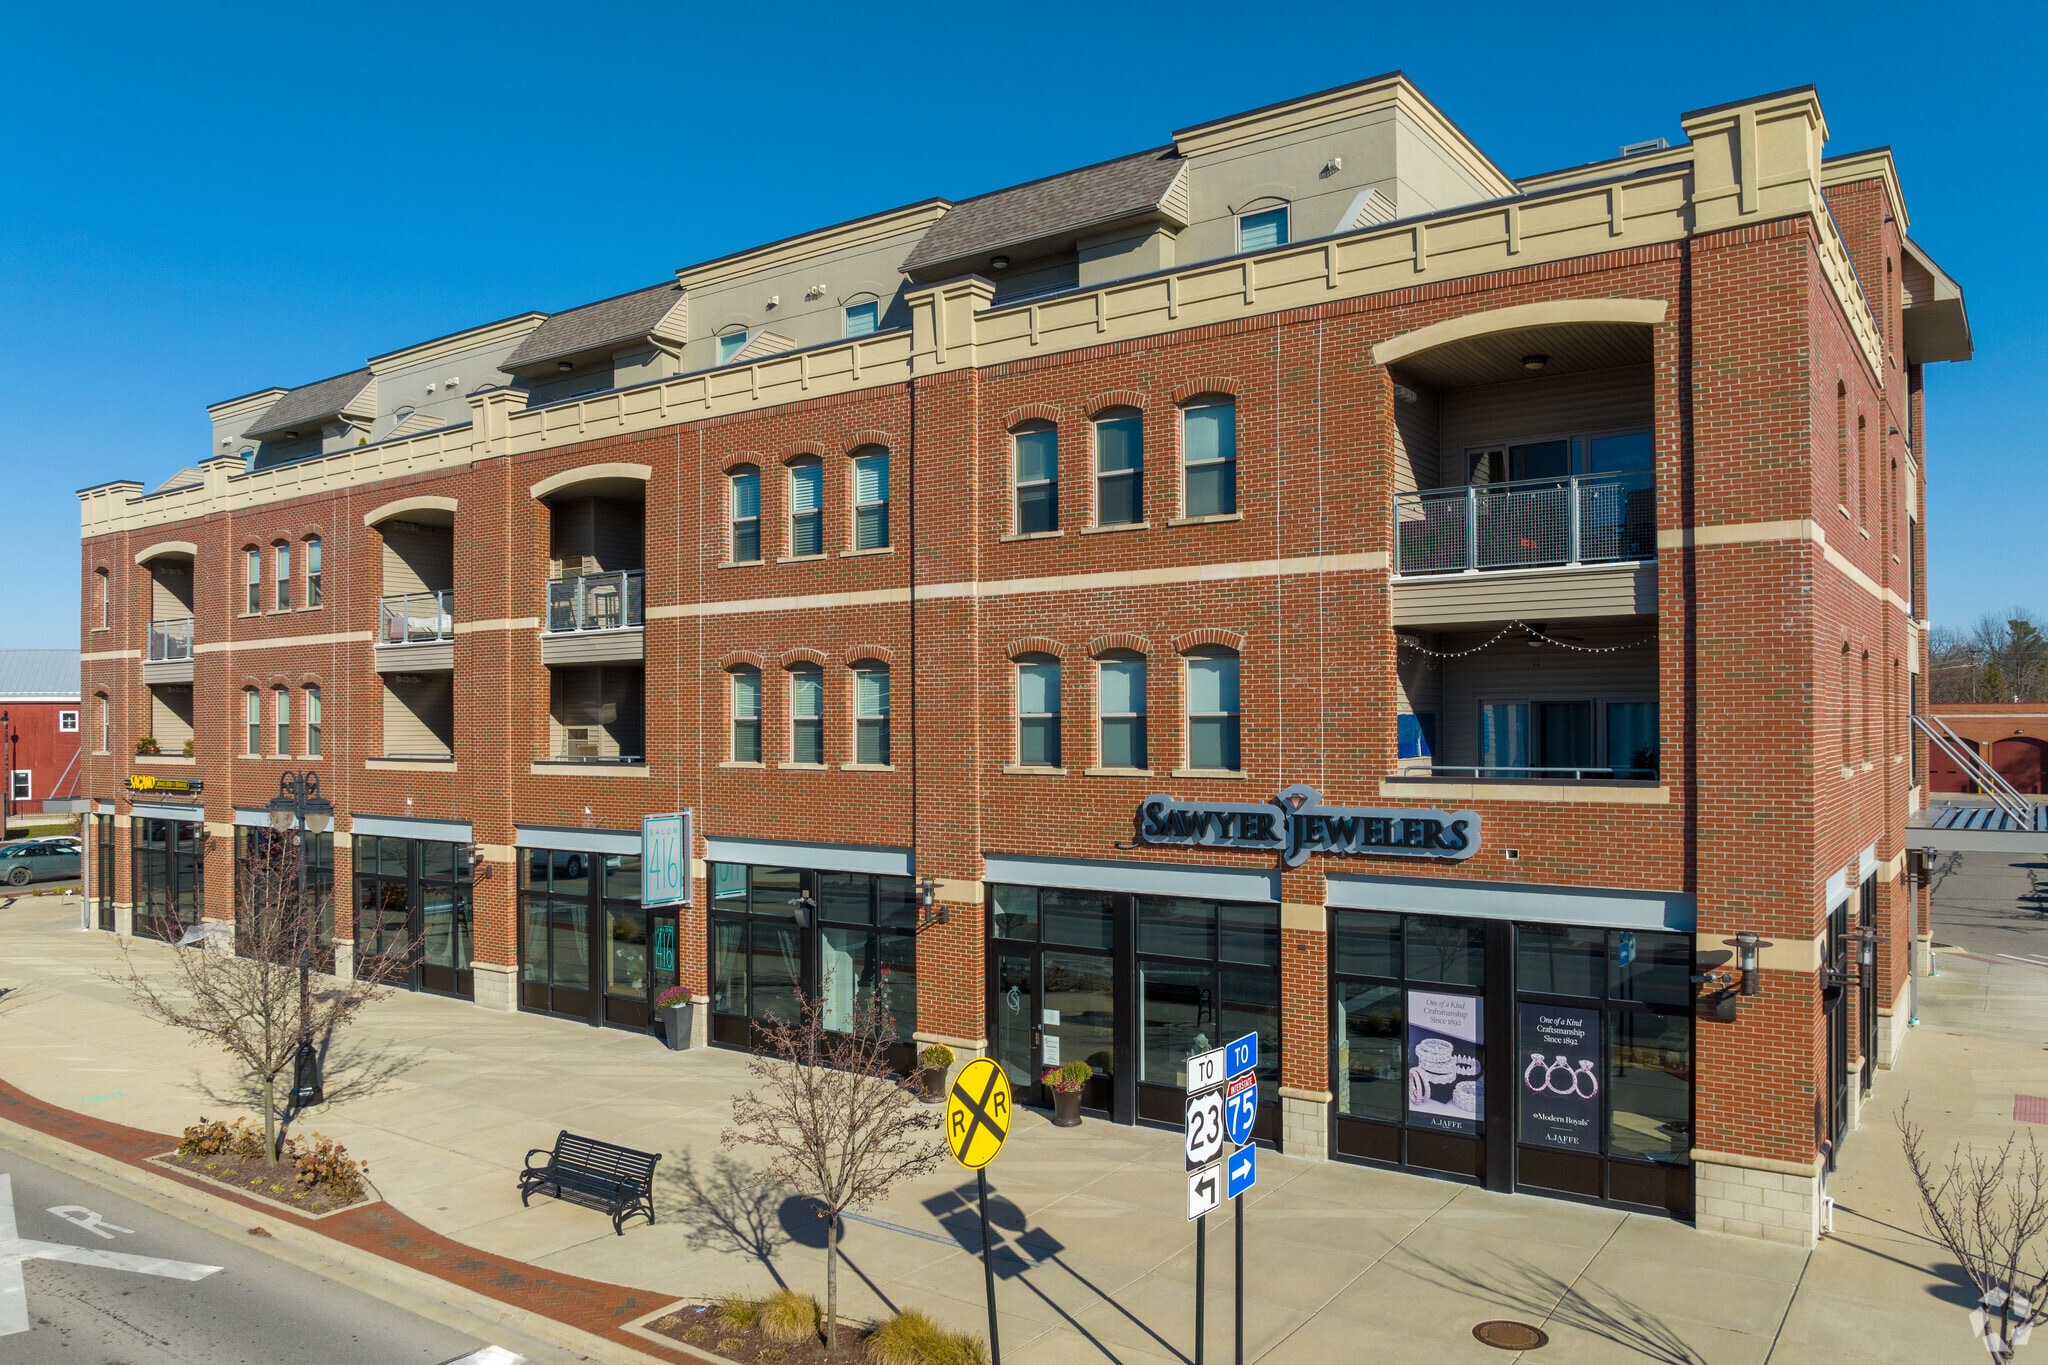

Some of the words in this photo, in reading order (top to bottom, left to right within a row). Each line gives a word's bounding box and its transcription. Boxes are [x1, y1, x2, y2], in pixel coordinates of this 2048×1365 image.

[130, 775, 155, 791] SAGANO
[650, 827, 678, 837] SALON
[1145, 801, 1283, 842] SAWYER
[1288, 812, 1469, 859] JEWELERS
[650, 837, 678, 891] 416
[656, 932, 672, 968] 416
[1426, 999, 1438, 1007] One
[1438, 1000, 1445, 1008] of
[1450, 1001, 1466, 1009] Kind
[1423, 1007, 1468, 1020] Craftsmanship
[1430, 1016, 1447, 1024] Since
[1447, 1018, 1462, 1026] 1892
[1540, 1015, 1553, 1024] One
[1553, 1017, 1561, 1026] of
[1566, 1018, 1583, 1027] Kind
[1536, 1024, 1586, 1039] Craftsmanship
[1543, 1034, 1562, 1044] Since
[1563, 1037, 1578, 1046] 1892
[1235, 1044, 1249, 1067] TO
[1199, 1059, 1214, 1082] TO
[1230, 1078, 1253, 1095] INTERSTATE
[952, 1109, 966, 1137] R
[993, 1091, 1007, 1117] R
[1228, 1090, 1254, 1136] 75
[1538, 1113, 1564, 1123] Modern
[1191, 1104, 1220, 1152] 23
[46, 1205, 136, 1239] R
